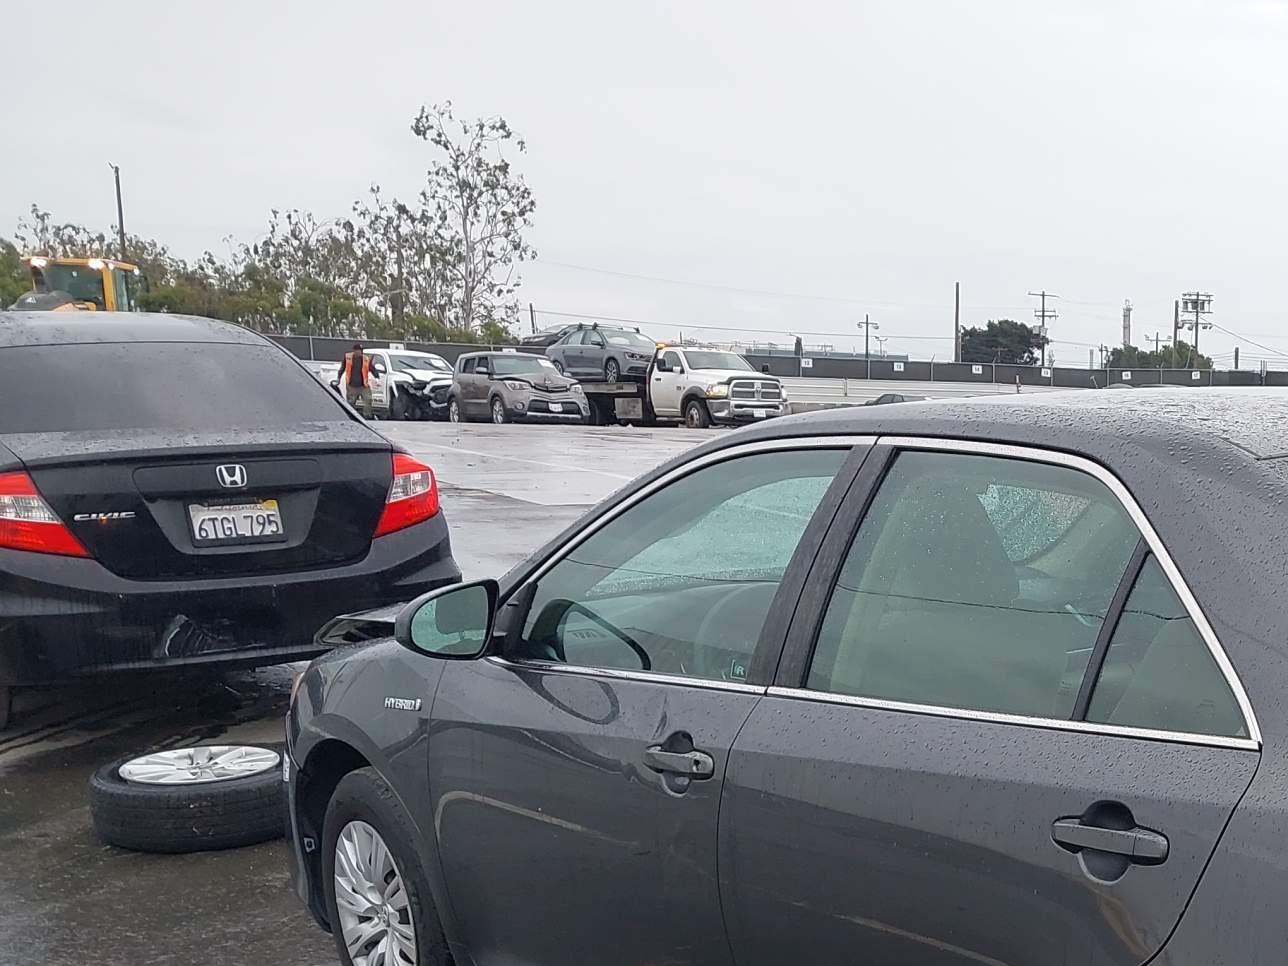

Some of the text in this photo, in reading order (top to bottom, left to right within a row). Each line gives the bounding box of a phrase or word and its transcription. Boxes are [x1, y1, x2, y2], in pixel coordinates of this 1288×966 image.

[74, 511, 136, 521] CIVIC
[199, 513, 279, 539] 6TGL795
[384, 697, 415, 711] HYBRID
